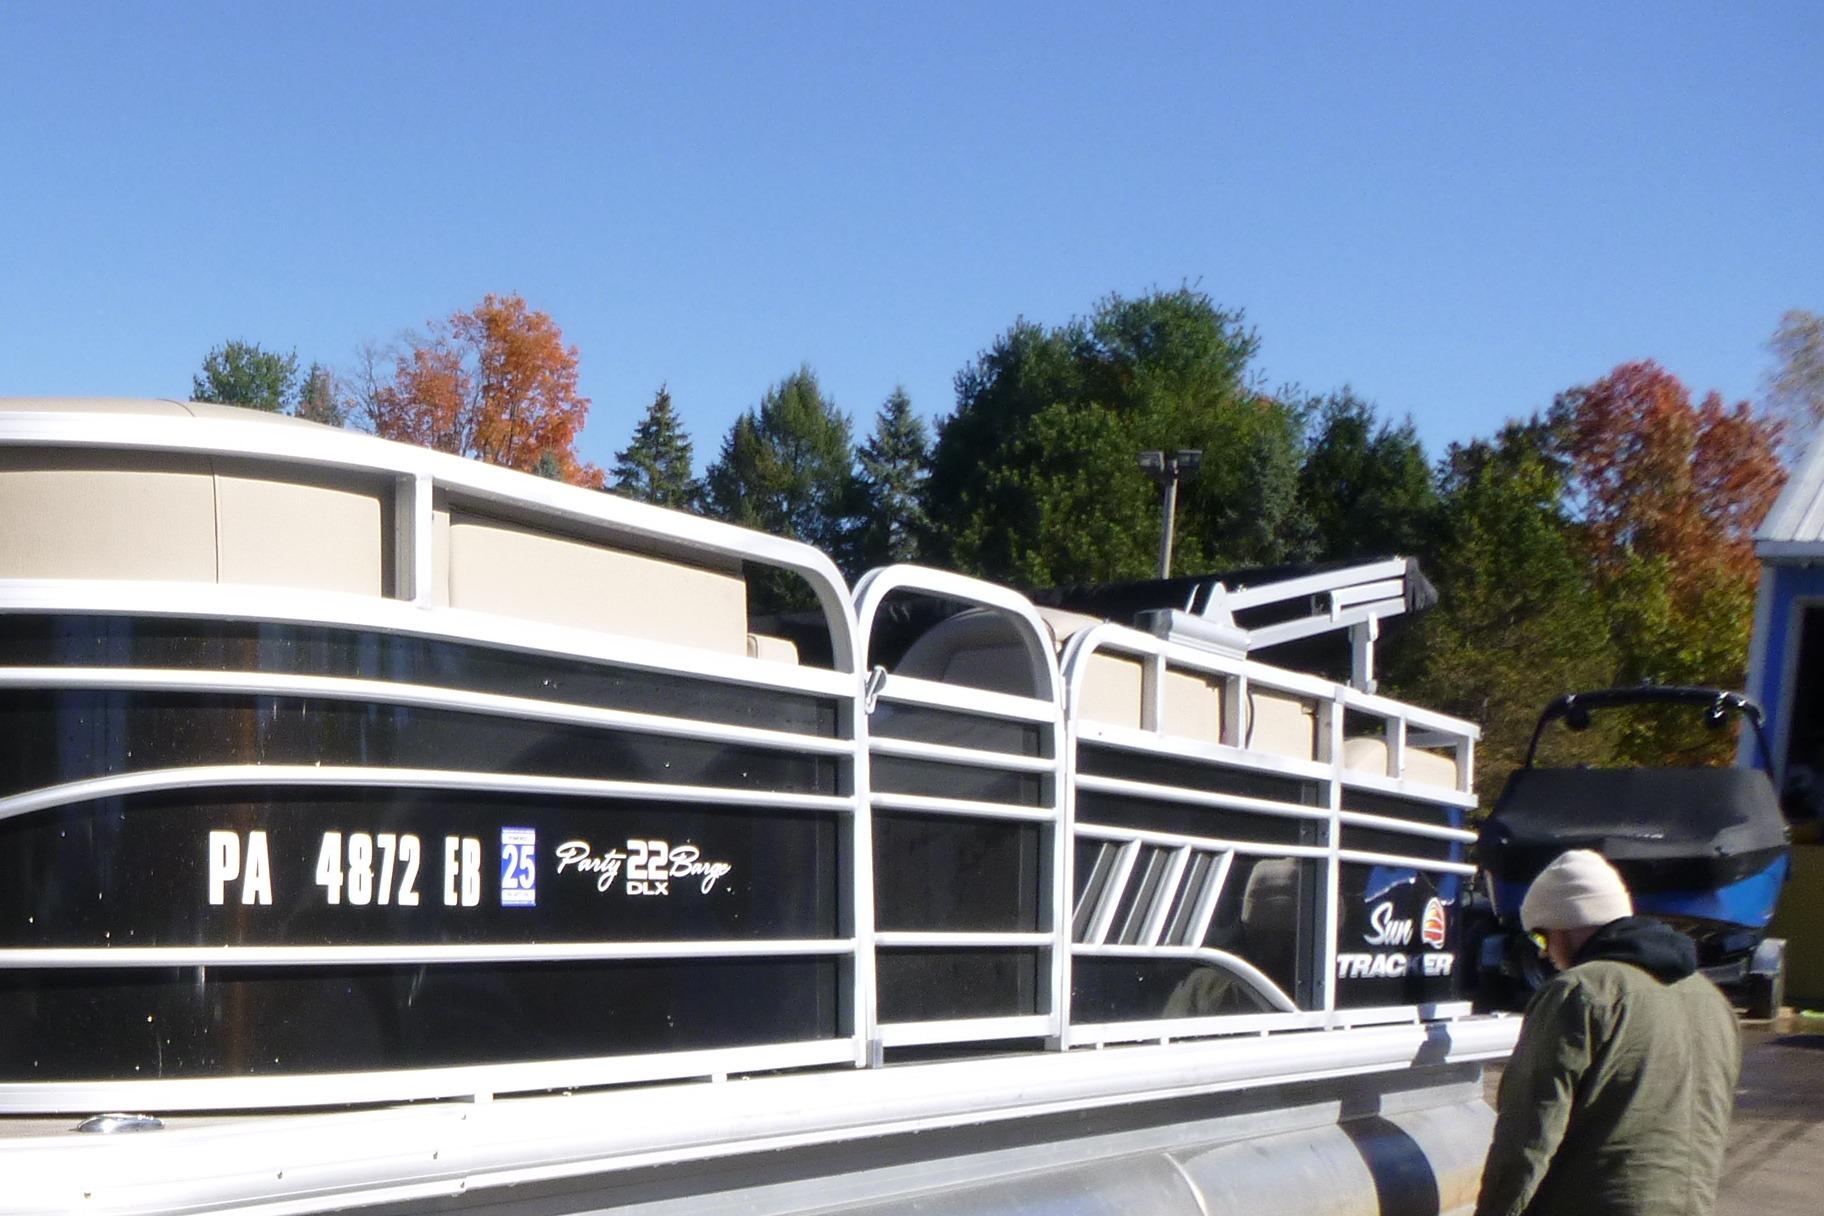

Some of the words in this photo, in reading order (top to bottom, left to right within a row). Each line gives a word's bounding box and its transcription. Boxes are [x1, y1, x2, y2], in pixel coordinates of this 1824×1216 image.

[209, 831, 273, 905] PA
[315, 832, 420, 906] 4872
[444, 836, 481, 906] EB
[502, 844, 536, 889] 25
[556, 840, 627, 893] Party
[626, 839, 669, 880] 22
[669, 845, 733, 894] Barge
[626, 881, 669, 895] DLX
[1363, 901, 1413, 946] Sun
